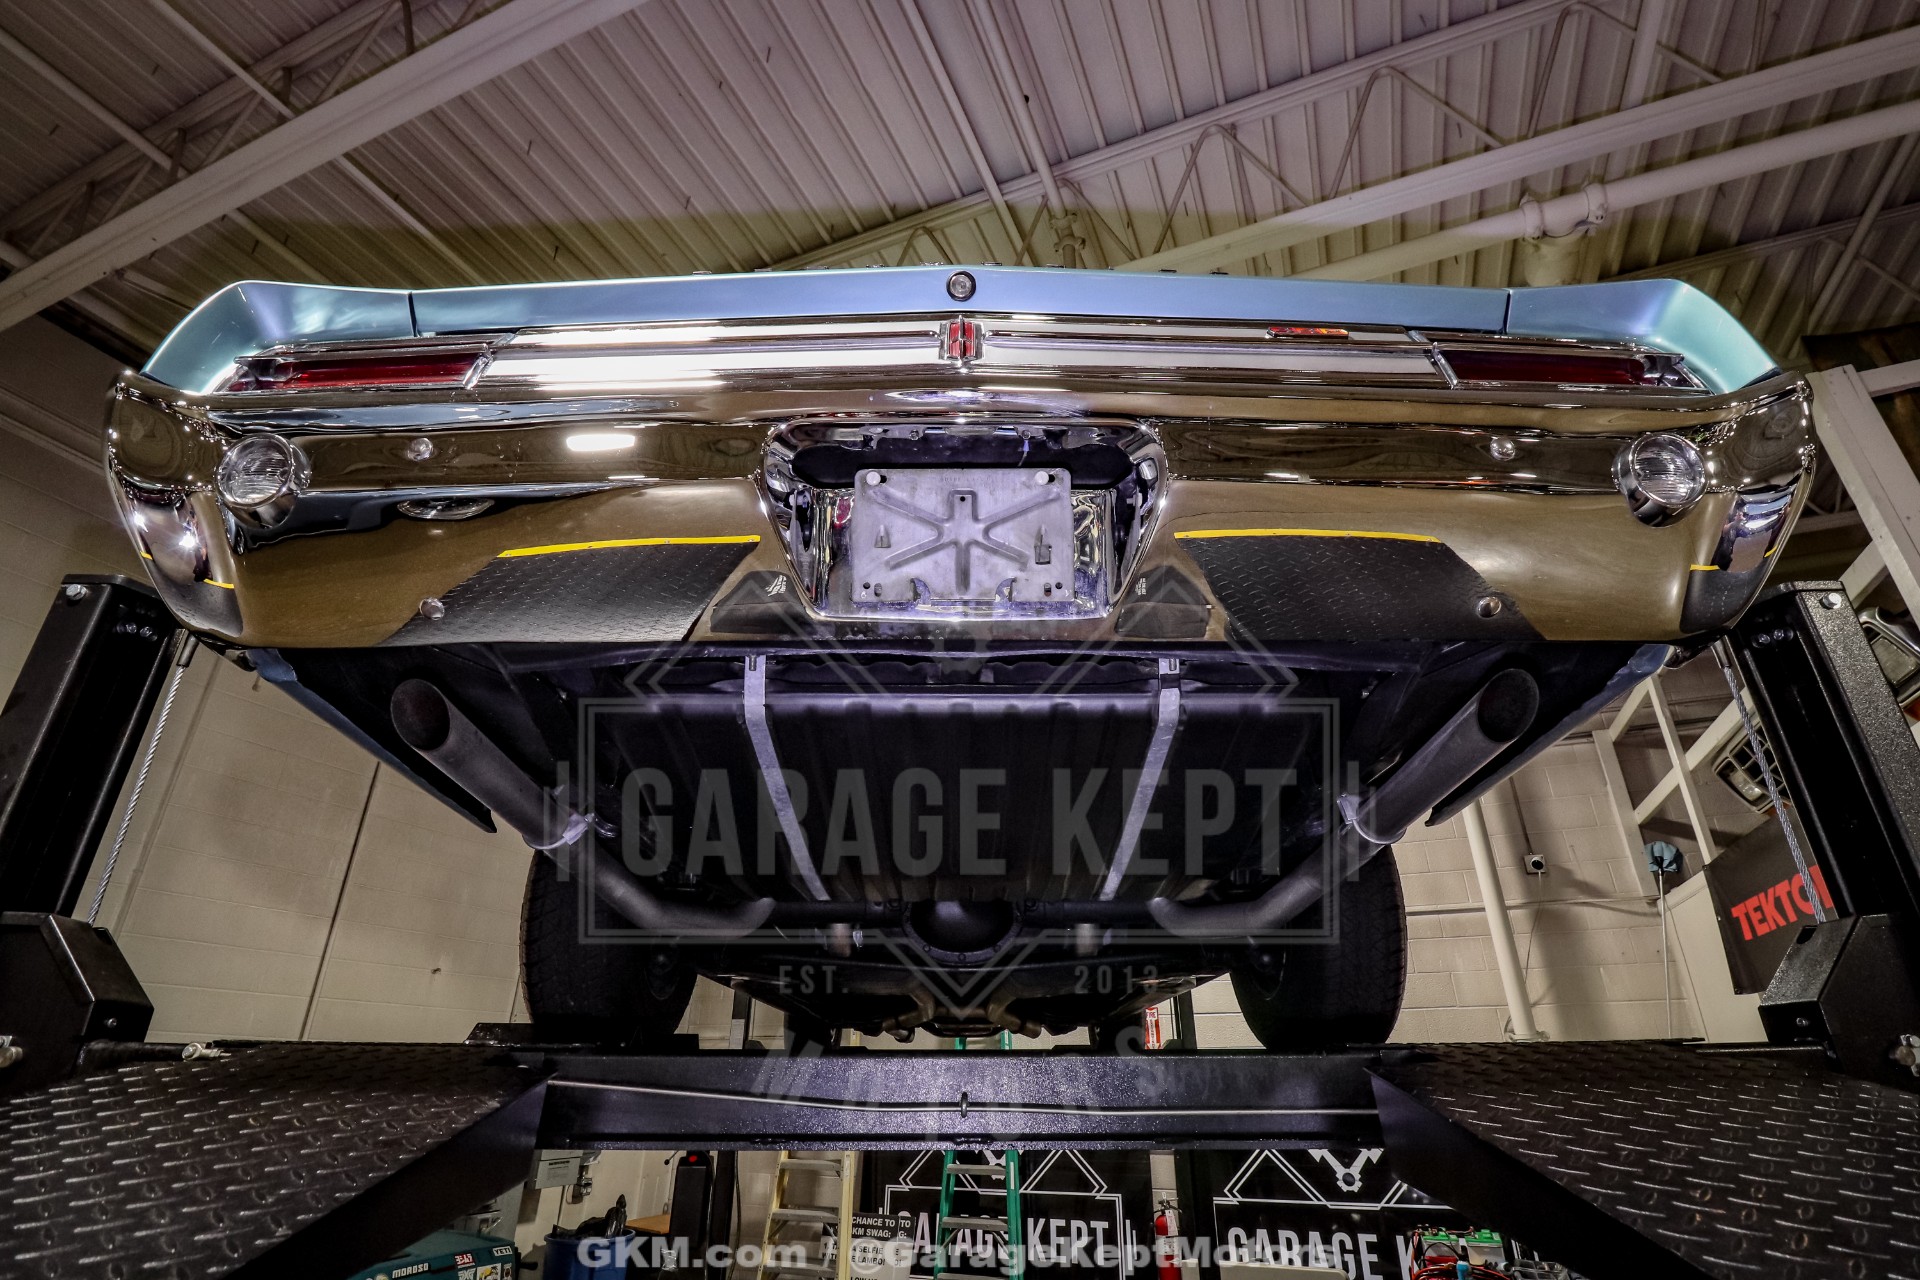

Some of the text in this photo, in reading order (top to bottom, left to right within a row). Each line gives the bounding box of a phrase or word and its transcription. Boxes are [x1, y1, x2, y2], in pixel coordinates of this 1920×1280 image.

[884, 1218, 896, 1227] TO
[866, 1229, 891, 1239] SWAG:
[1027, 1216, 1109, 1269] KEPT
[494, 1247, 511, 1256] YETI
[392, 1262, 429, 1279] MOROSO
